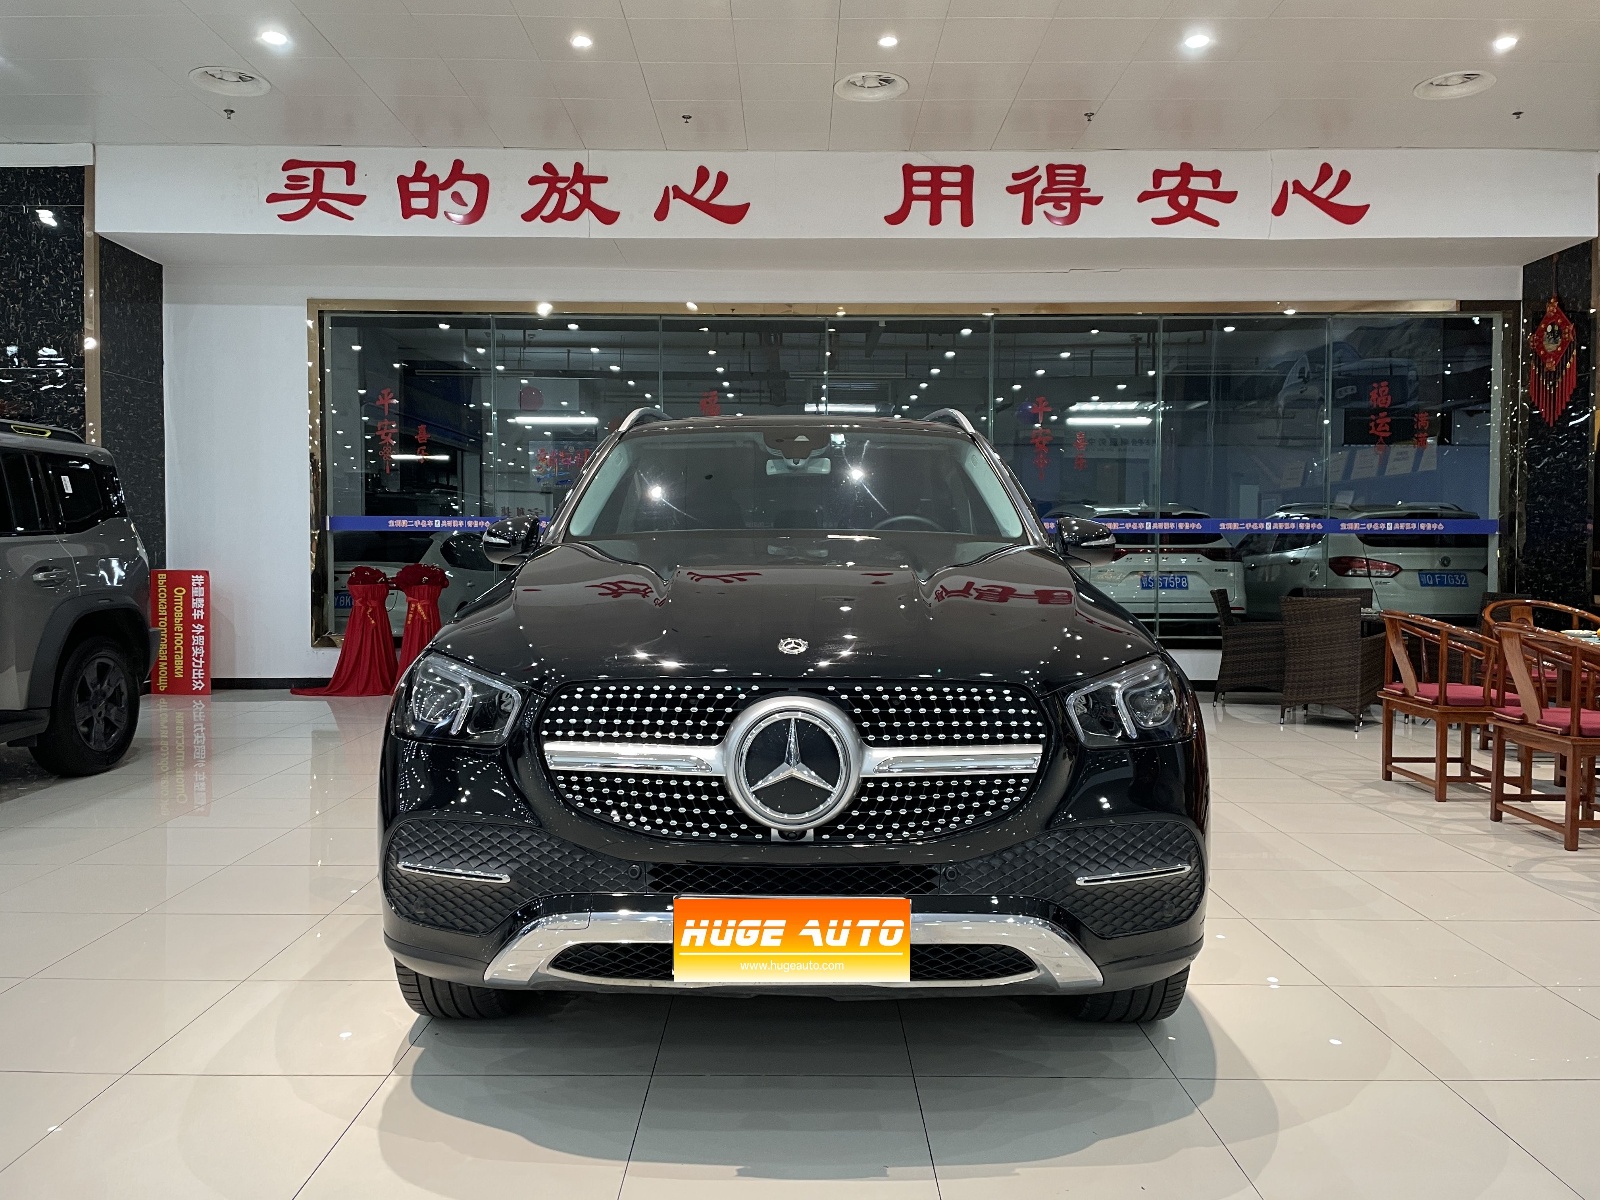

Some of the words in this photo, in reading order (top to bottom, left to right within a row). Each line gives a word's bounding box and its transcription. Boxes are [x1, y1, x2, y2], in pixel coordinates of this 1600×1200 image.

[266, 158, 751, 226] 买的放心
[884, 161, 1371, 227] 用得安心
[375, 388, 399, 445] 平安
[1030, 396, 1054, 453] 平安
[1369, 381, 1392, 437] 福运
[173, 586, 186, 632] Оптовые
[191, 574, 205, 620] 批量整车
[174, 632, 185, 678] поставки
[191, 623, 205, 691] 外贸实力出众
